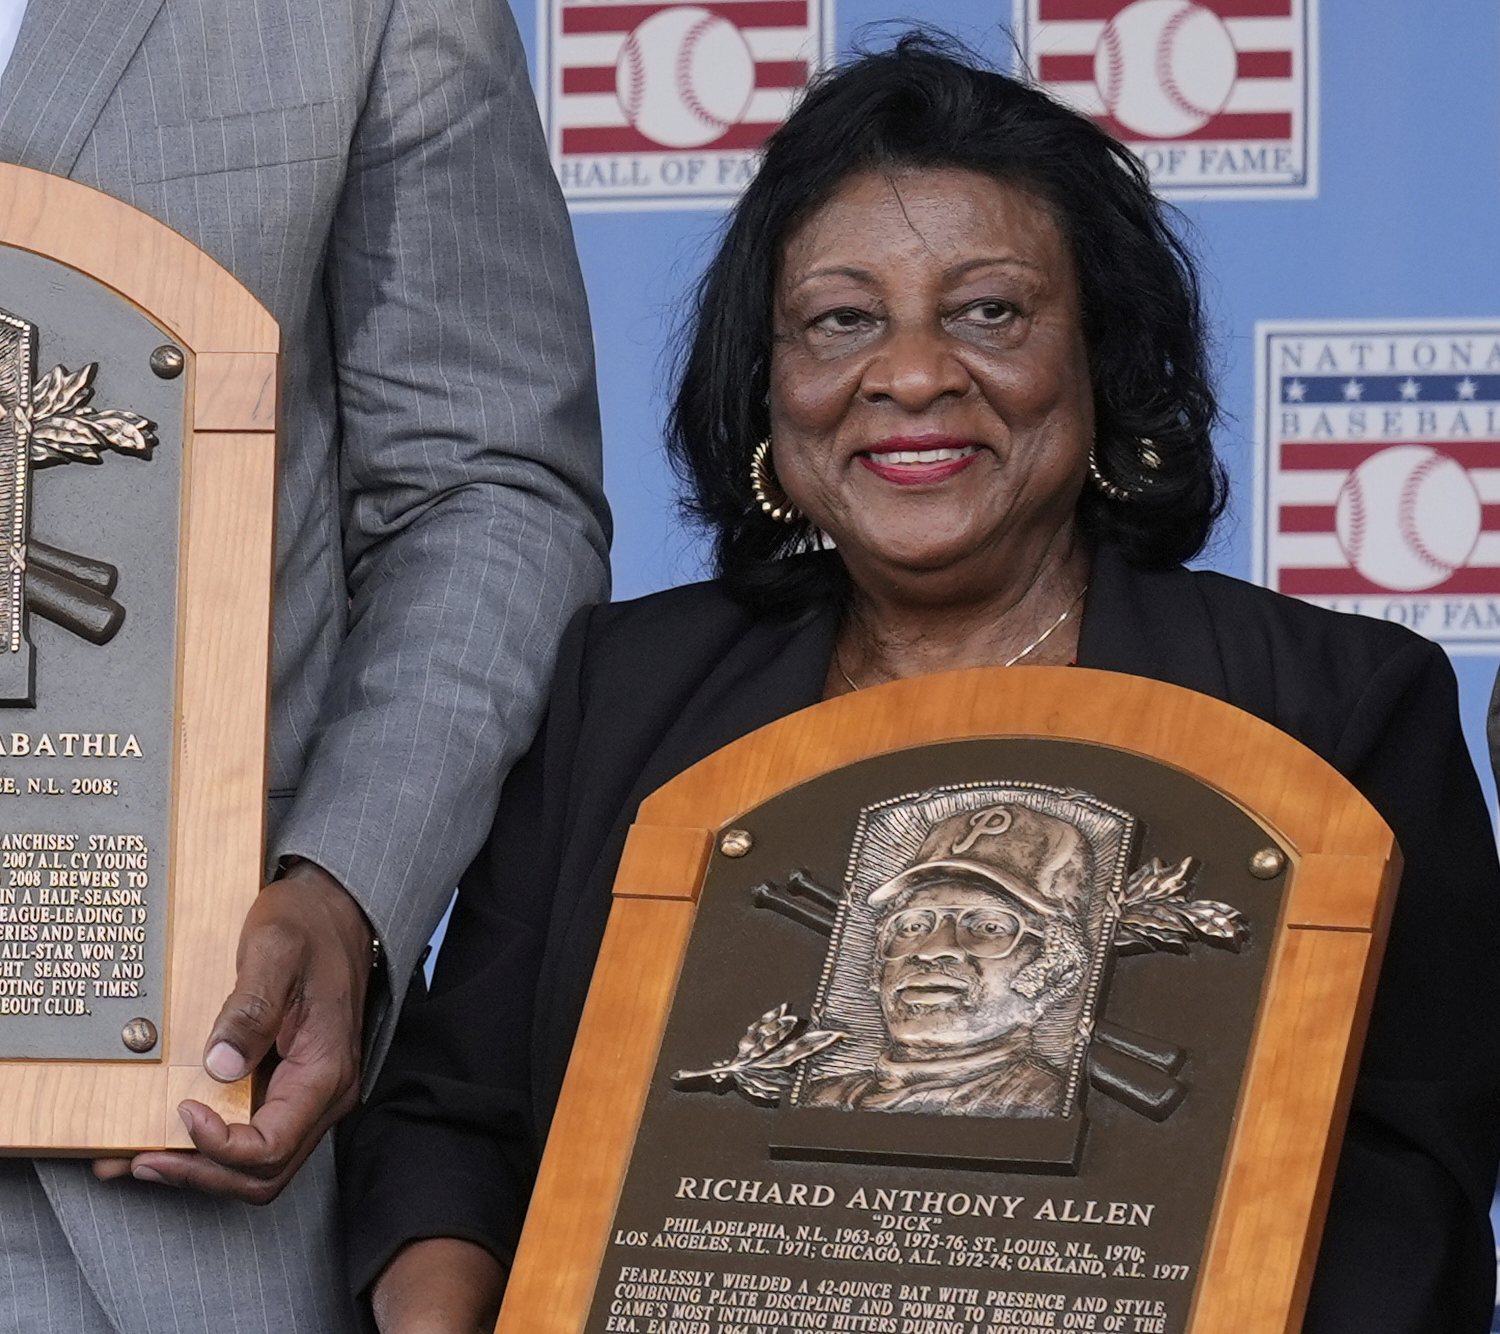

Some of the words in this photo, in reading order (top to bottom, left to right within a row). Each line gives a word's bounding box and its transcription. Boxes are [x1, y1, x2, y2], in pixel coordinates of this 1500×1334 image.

[561, 160, 651, 188] HALL
[660, 158, 705, 186] OF
[1144, 150, 1187, 175] OF
[1196, 147, 1293, 175] FAME
[1383, 601, 1430, 628] OF
[27, 777, 65, 794] N.L.
[71, 778, 118, 796] 2008;
[44, 998, 95, 1017] CLUB.
[674, 1177, 836, 1207] RICHARD
[845, 1187, 1025, 1219] ANTHONY
[1033, 1198, 1156, 1227] ALLEN
[662, 1217, 791, 1241] PHILADELPHIA,
[795, 1225, 828, 1243] N.L.
[834, 1228, 898, 1249] 1963-69,
[903, 1232, 969, 1253] 1975-76;
[972, 1236, 998, 1253] ST.
[1002, 1238, 1060, 1259] LOUIS,
[1064, 1242, 1099, 1259] N.L.
[1104, 1244, 1146, 1264] 1970;
[614, 1231, 649, 1247] LOS
[651, 1233, 733, 1254] ANGELES,
[737, 1238, 770, 1254] N.L.
[776, 1240, 817, 1259] 1971;
[820, 1243, 904, 1265] CHICAGO,
[908, 1248, 942, 1266] A.L.
[947, 1250, 1013, 1272] 1972-74;
[1017, 1255, 1107, 1277] OAKLAND,
[1112, 1262, 1146, 1278] A.L.
[1152, 1264, 1190, 1281] 1977
